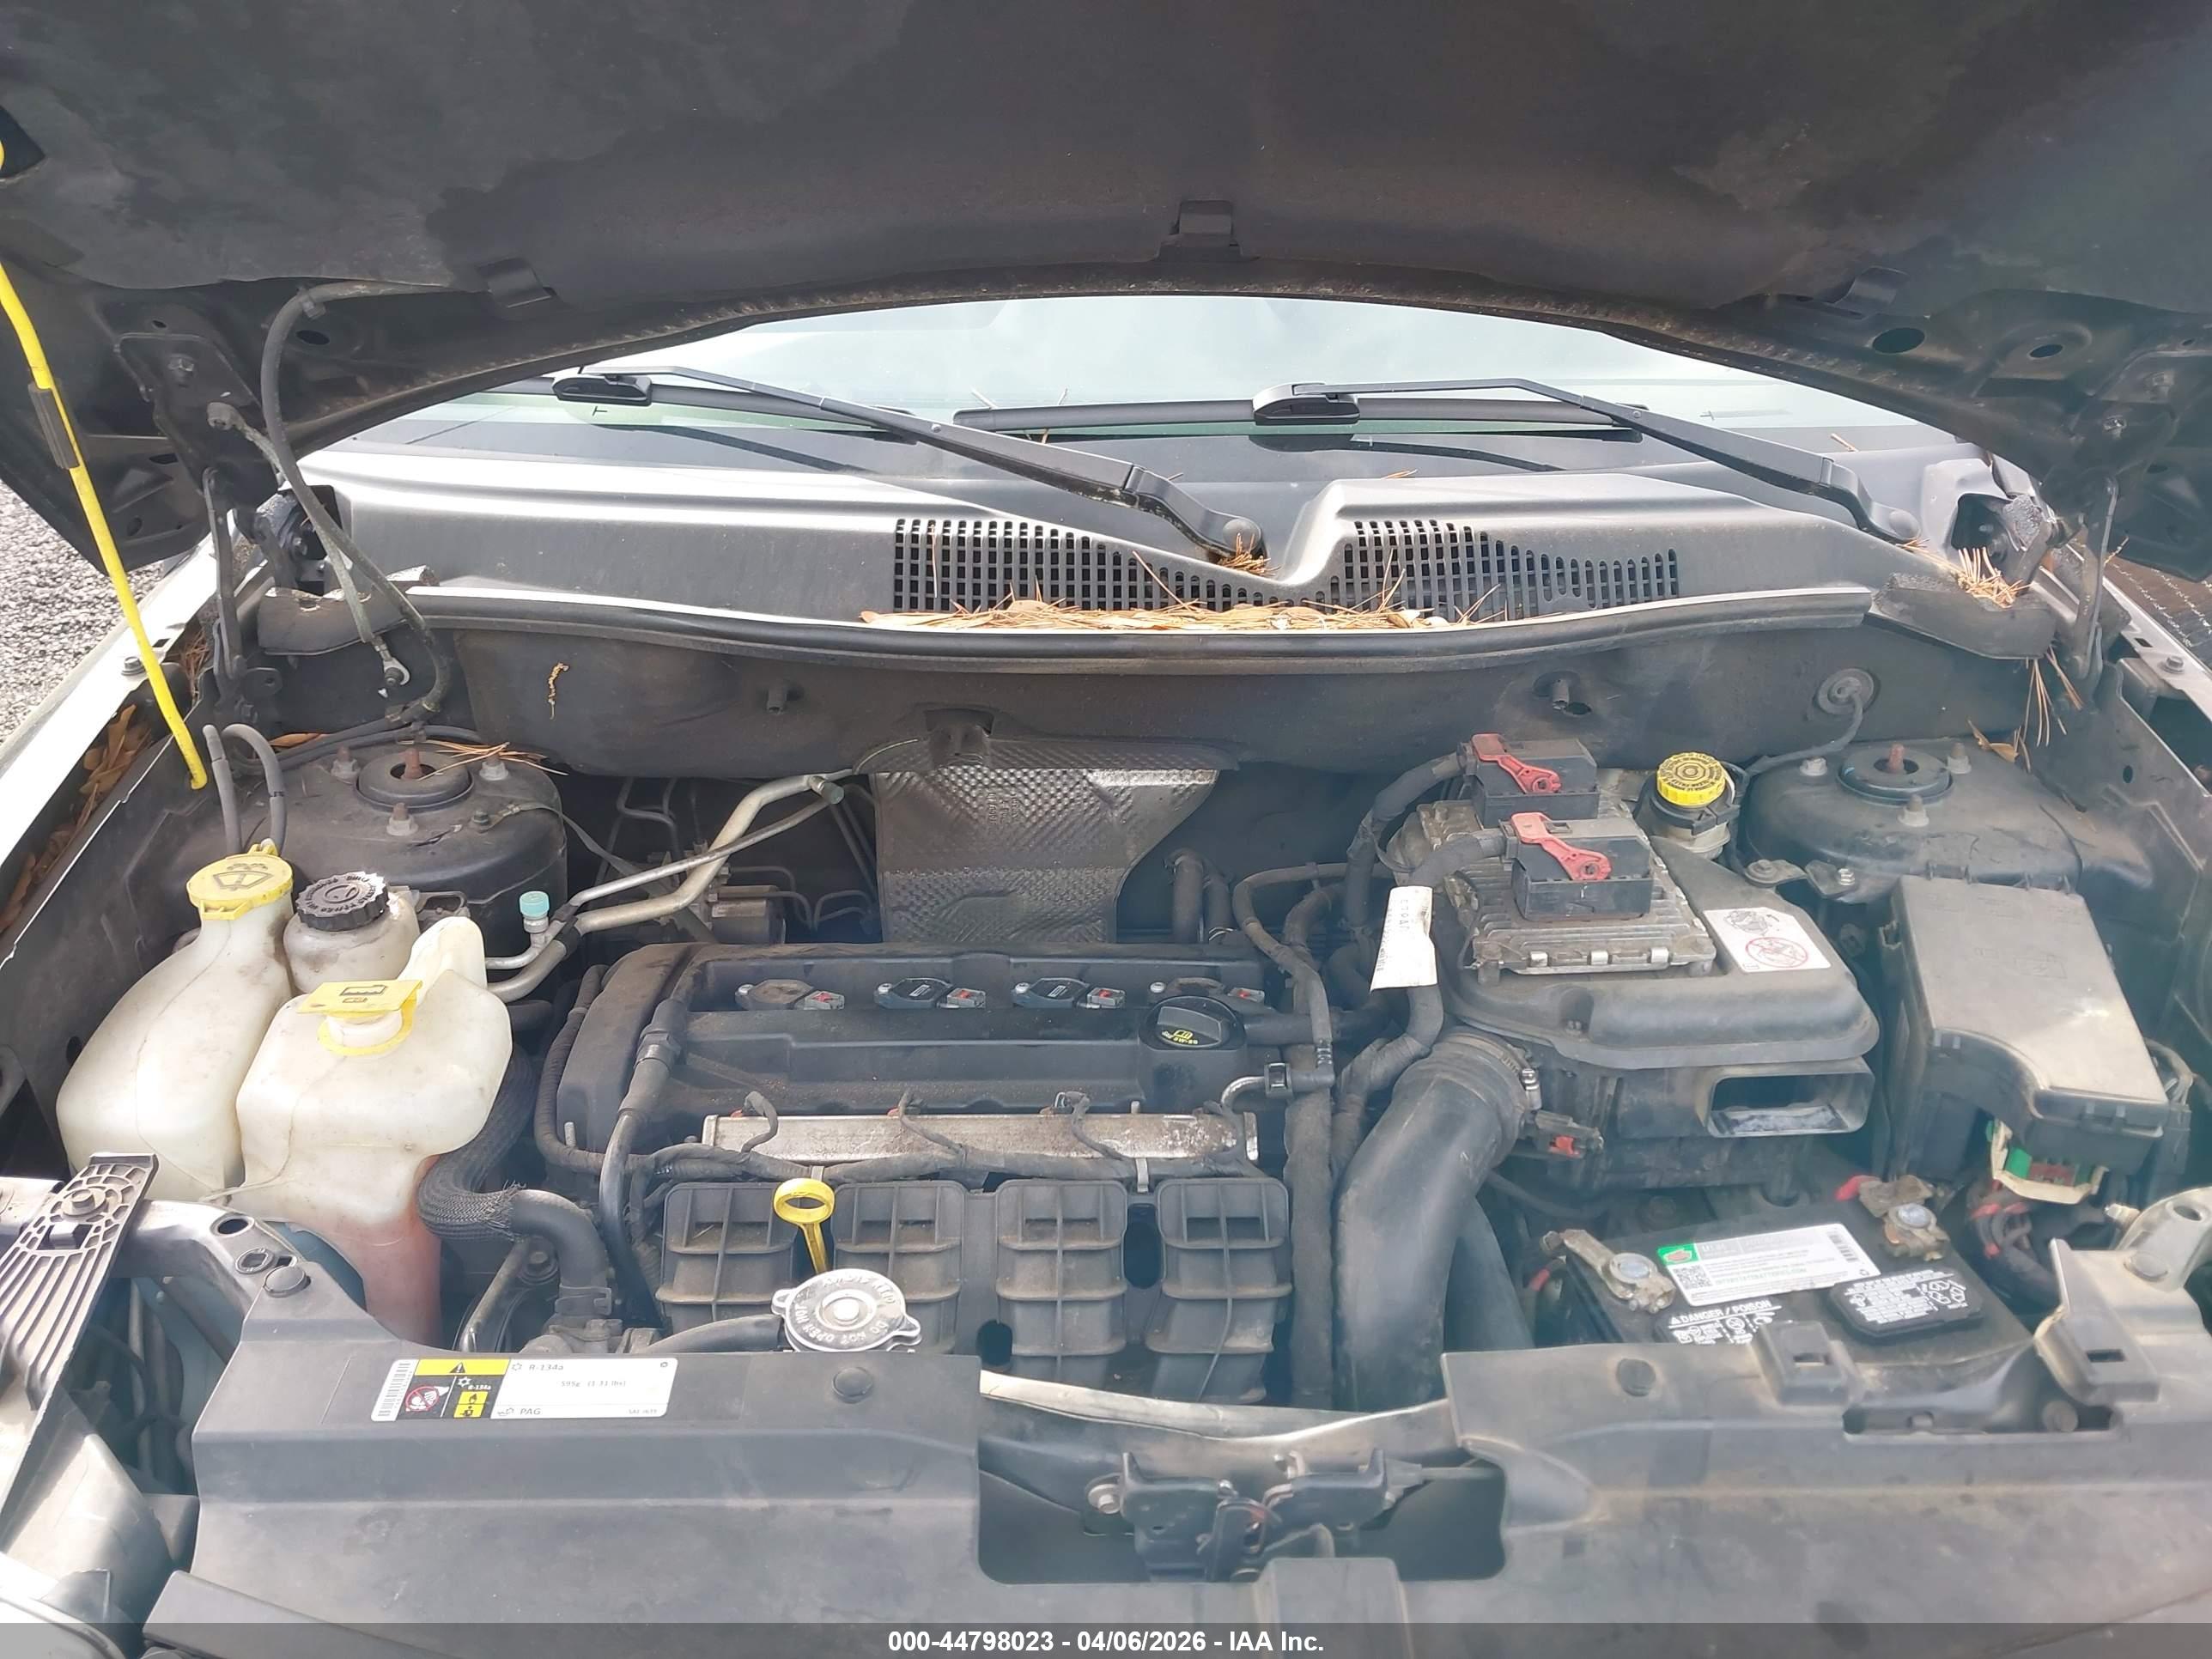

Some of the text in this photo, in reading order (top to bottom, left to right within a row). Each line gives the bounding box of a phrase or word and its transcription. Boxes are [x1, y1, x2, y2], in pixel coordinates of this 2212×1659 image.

[1680, 1309, 1723, 1323] DANGER
[1732, 1300, 1771, 1313] POISON
[794, 1304, 890, 1346] DO NOT OPEN HOT
[520, 1407, 541, 1416] PAG
